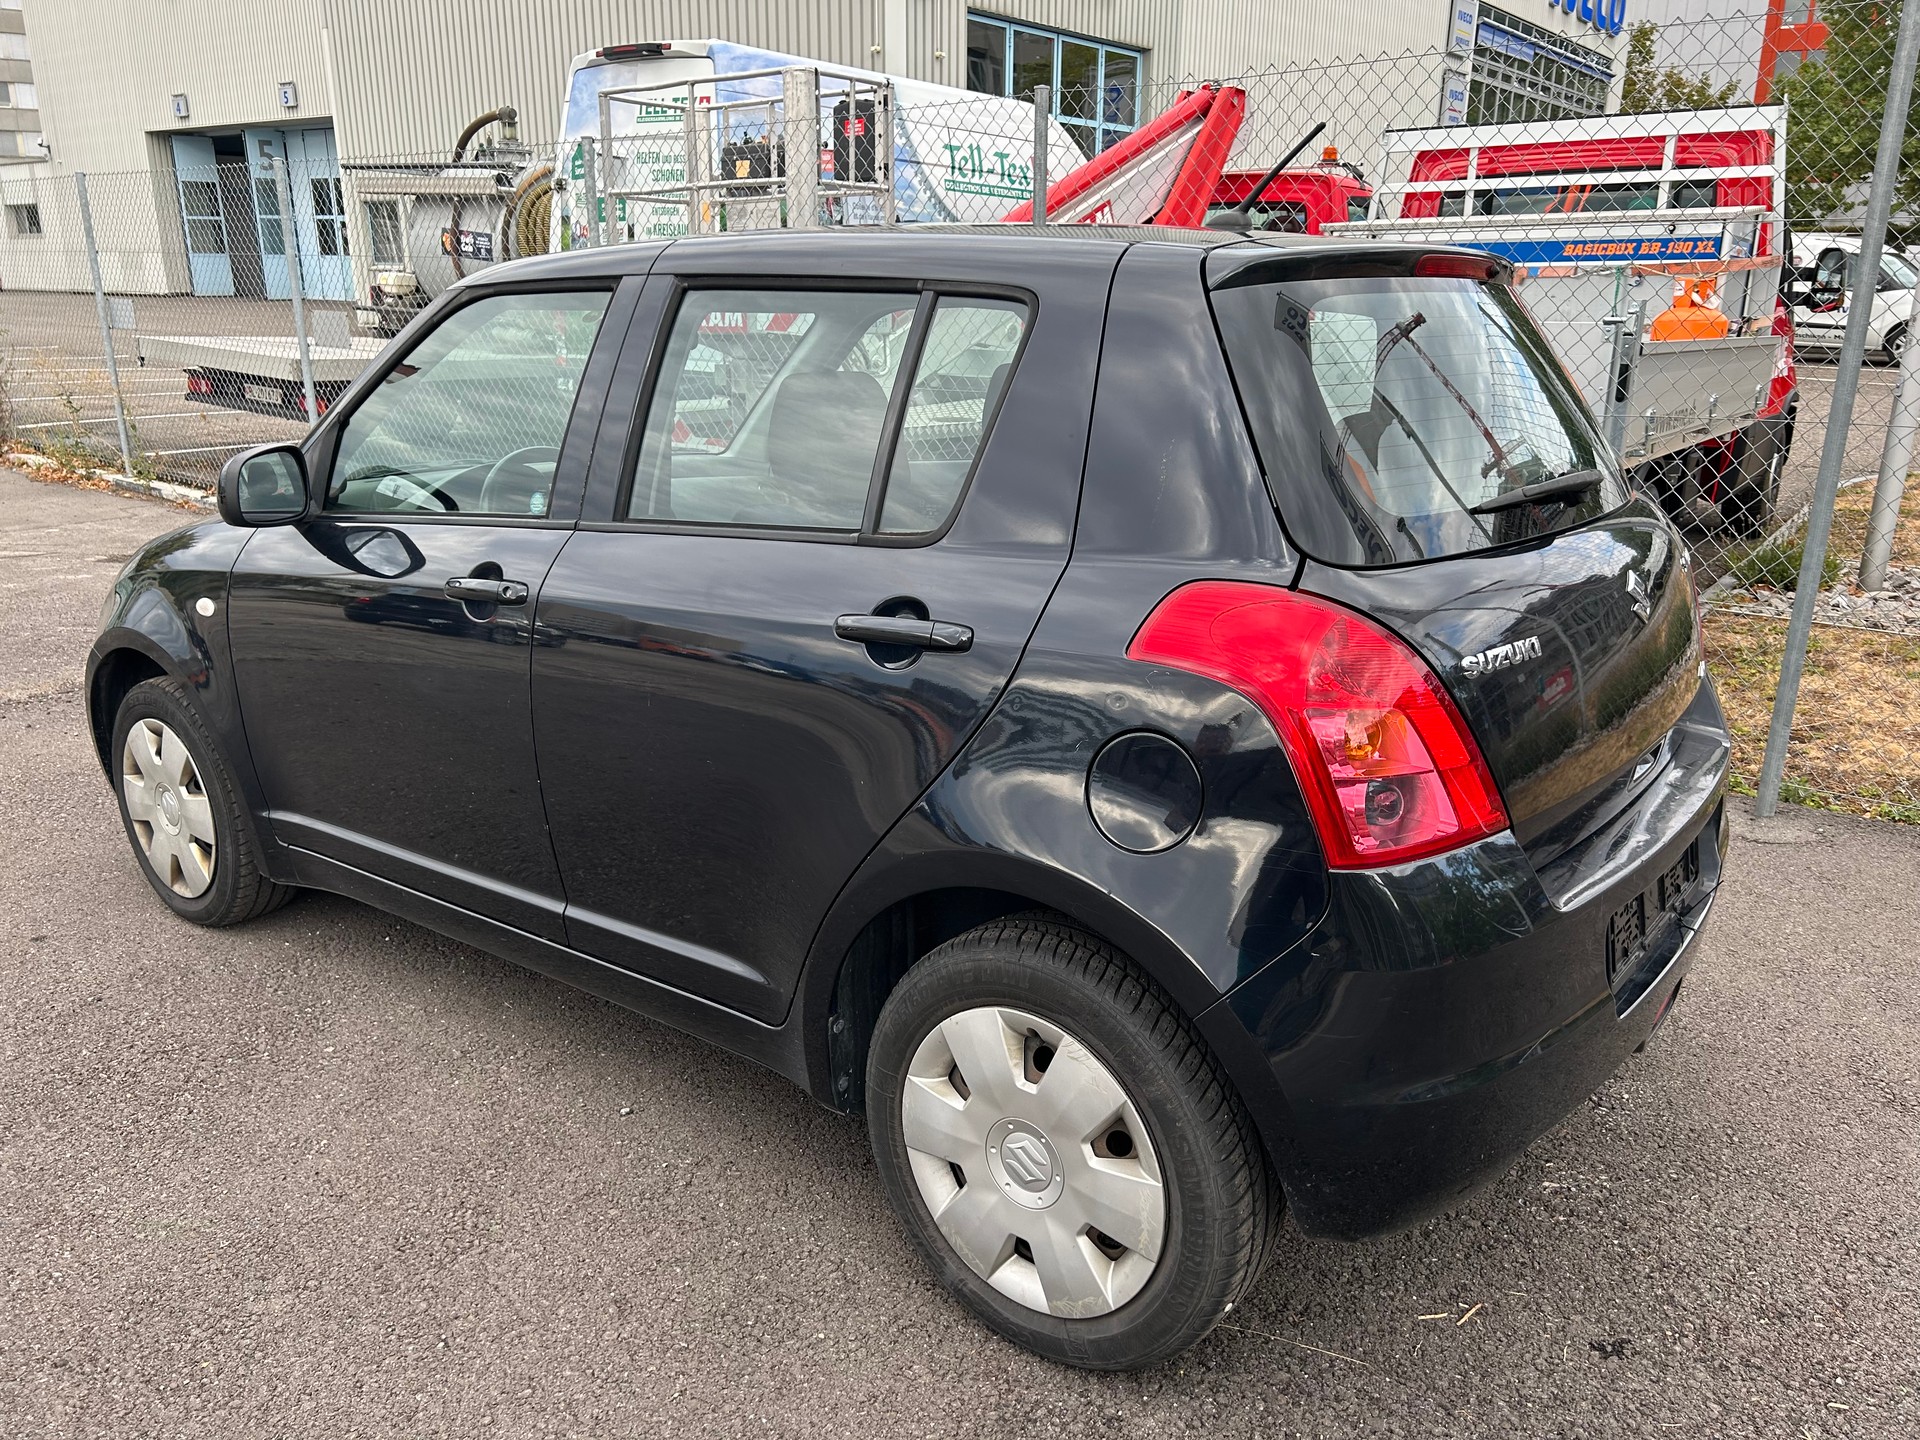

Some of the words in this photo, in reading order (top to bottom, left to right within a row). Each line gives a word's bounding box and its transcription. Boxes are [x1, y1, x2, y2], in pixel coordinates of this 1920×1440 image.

[1457, 10, 1473, 25] IVECO
[283, 90, 289, 104] 5
[1449, 88, 1464, 102] IVECO
[176, 102, 181, 115] 4
[258, 139, 276, 171] 5
[636, 152, 660, 165] HELFEN
[942, 143, 1031, 187] Tell-Tex
[945, 181, 981, 191] COLLECTION
[982, 185, 991, 194] DE
[1563, 243, 1635, 256] BASICBOX
[1694, 241, 1715, 253] XL
[1461, 635, 1542, 680] SUZUKI
